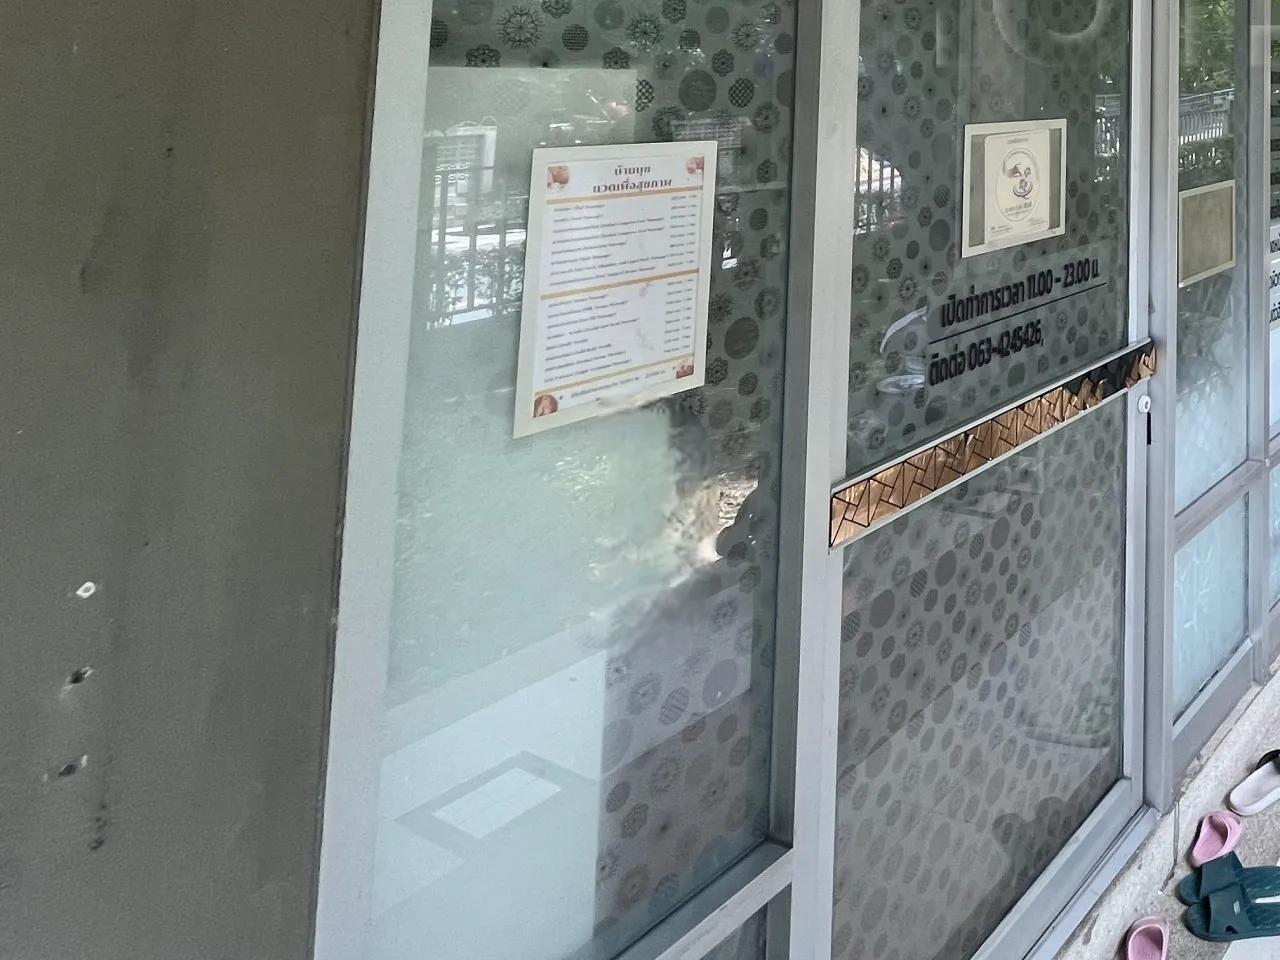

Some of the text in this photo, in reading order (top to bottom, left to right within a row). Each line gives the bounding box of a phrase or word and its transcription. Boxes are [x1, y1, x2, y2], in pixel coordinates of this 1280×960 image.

[940, 284, 1025, 328] เปิดทำการเวลา
[929, 343, 966, 387] ติดต่อ
